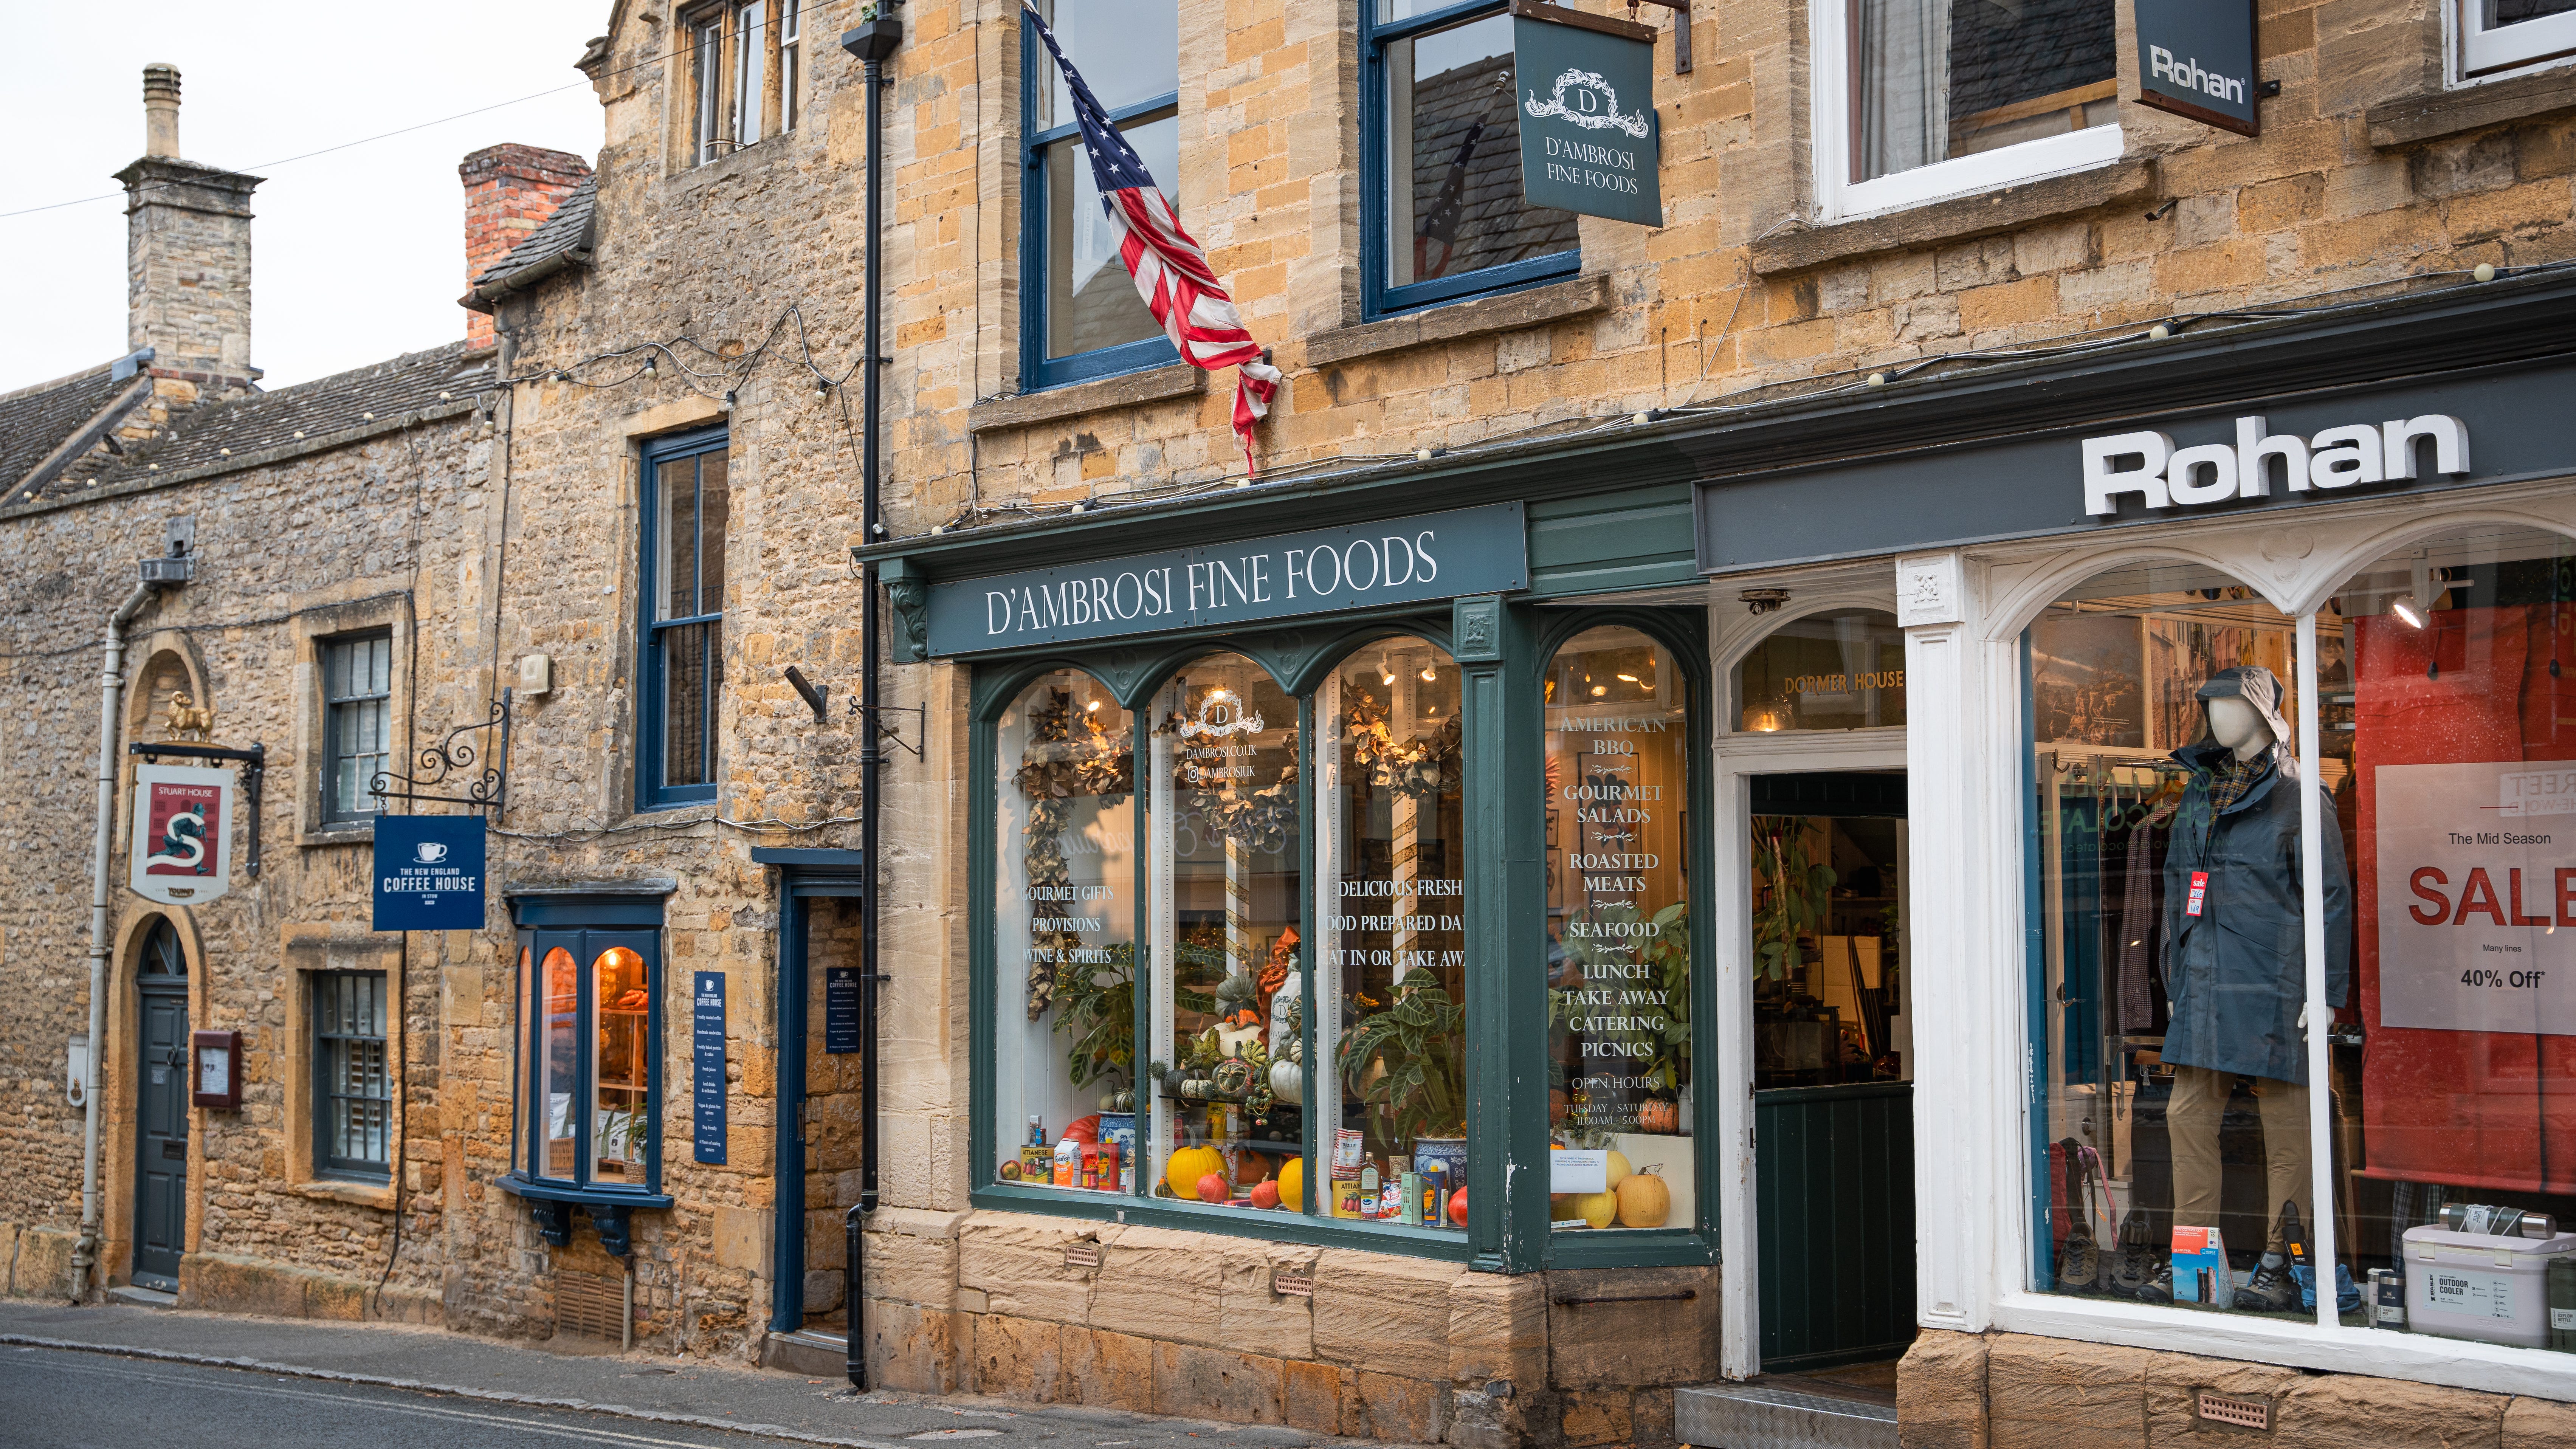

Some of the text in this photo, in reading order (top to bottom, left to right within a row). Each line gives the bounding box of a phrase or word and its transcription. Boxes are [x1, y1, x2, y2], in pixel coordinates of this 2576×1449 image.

[2150, 44, 2243, 104] Rohan
[1578, 88, 1596, 113] D
[1545, 136, 1635, 170] D'AMBROSI
[1547, 163, 1637, 194] FINE FOODS
[2082, 414, 2470, 516] Rohan
[986, 530, 1437, 635] D'AMBROSI FINE FOODS
[1785, 670, 1904, 697] DORMER HOUSE
[1215, 705, 1229, 724] D
[1560, 717, 1666, 733] AMERICAN
[1186, 744, 1257, 760] DAMBROSI.CO.UK
[1593, 740, 1634, 757] BBQ
[158, 787, 213, 797] STUART HOUSE
[1564, 785, 1664, 801] GOURMET
[1577, 808, 1650, 823] SALADS
[2448, 833, 2551, 845] The Mid Season
[1569, 854, 1659, 869] ROASTED
[384, 877, 475, 893] COFFEE HOUSE
[1338, 879, 1463, 897] DELICIOUS FRESH
[1583, 877, 1646, 891] MEATS
[2193, 879, 2204, 887] sale
[1021, 885, 1113, 901] GOURMET GIFTS
[2408, 866, 2576, 927] SALE
[2191, 905, 2199, 913] 169
[1032, 917, 1100, 932] PROVISIONS
[1361, 915, 1435, 931] PREPARED
[1570, 922, 1659, 938] SEAFOOD
[1023, 948, 1111, 964] WINE & SPIRITS
[2483, 944, 2503, 953] Many
[1350, 950, 1367, 966] IN
[1371, 950, 1392, 966] OR
[1398, 950, 1435, 966] TAKE
[1440, 950, 1465, 966] AW
[1583, 964, 1650, 979] LUNCH
[2461, 970, 2503, 988] 40%
[710, 998, 722, 1007] HOUSE
[1562, 990, 1670, 1005] TAKE AWAY
[1279, 1005, 1286, 1016] D
[1569, 1016, 1665, 1031] CATERING
[1581, 1042, 1653, 1057] PICNICS
[1572, 1077, 1660, 1089] OPEN HOURS
[1564, 1104, 1608, 1114] TUESDAY
[1617, 1103, 1668, 1113] SATURDAY
[1054, 1154, 1070, 1163] Goldfish
[2439, 1278, 2468, 1288] OUTDOOR
[2440, 1286, 2464, 1296] COOLER
